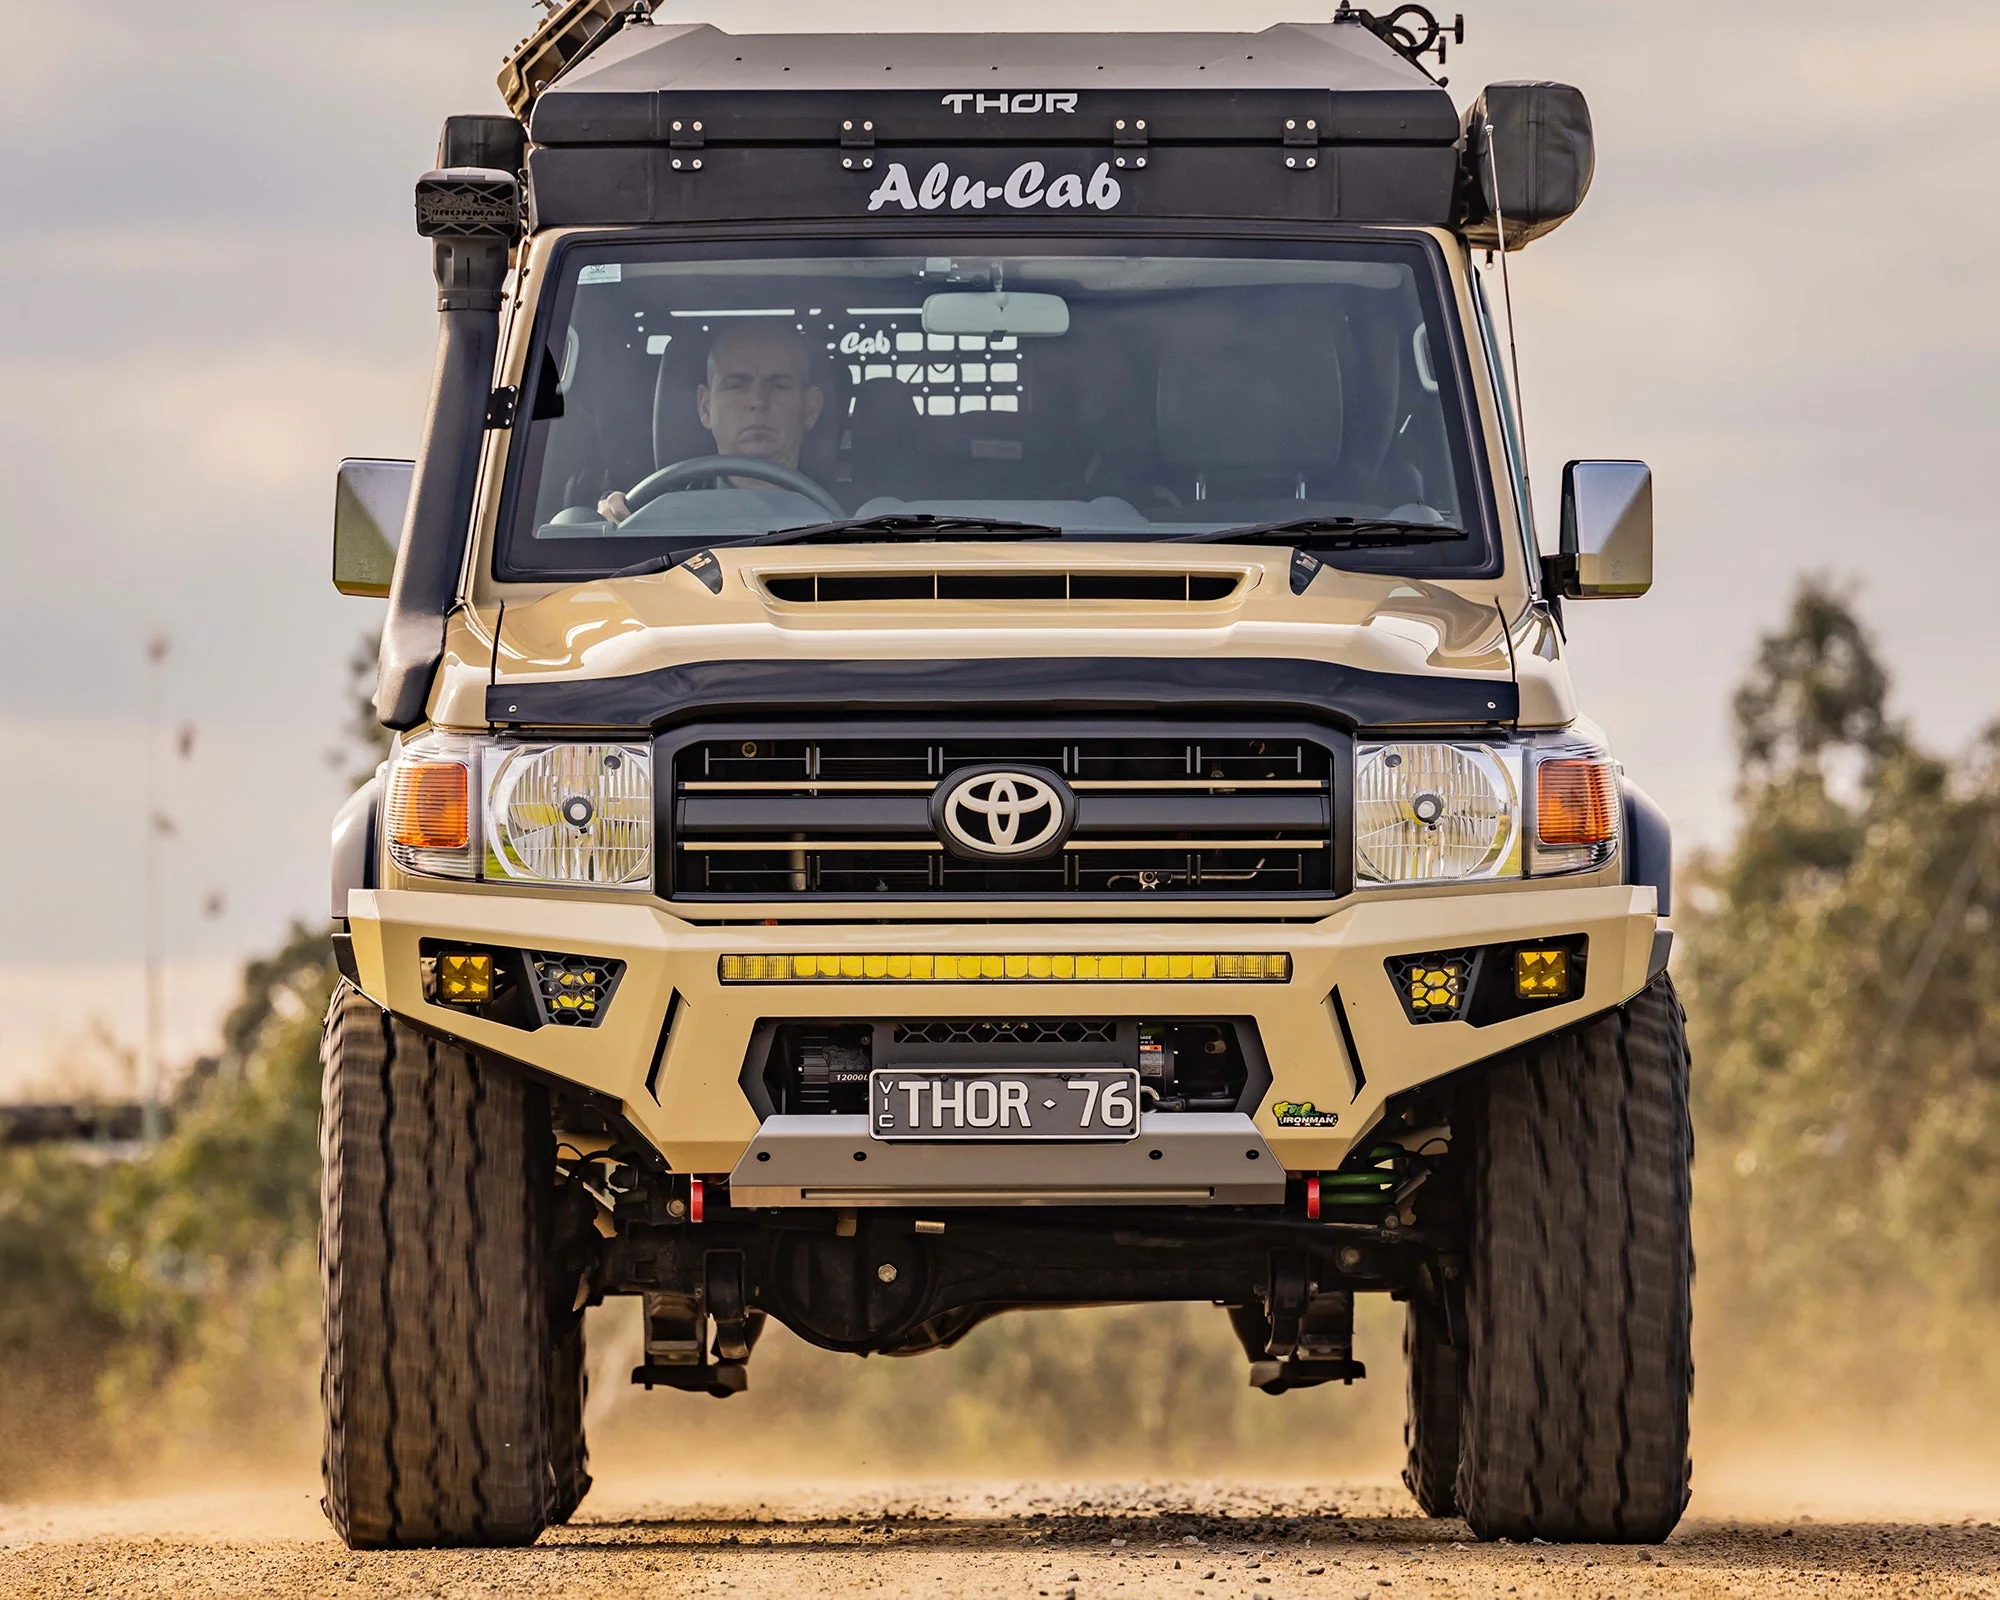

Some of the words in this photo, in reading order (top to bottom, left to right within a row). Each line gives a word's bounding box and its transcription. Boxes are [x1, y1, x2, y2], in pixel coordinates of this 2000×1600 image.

[941, 93, 1078, 114] THOR
[867, 161, 1121, 210] Alu-Cab
[434, 208, 507, 217] IRONMAN
[878, 1080, 895, 1128] VIC
[897, 1080, 1033, 1128] THOR
[1067, 1080, 1134, 1128] 76
